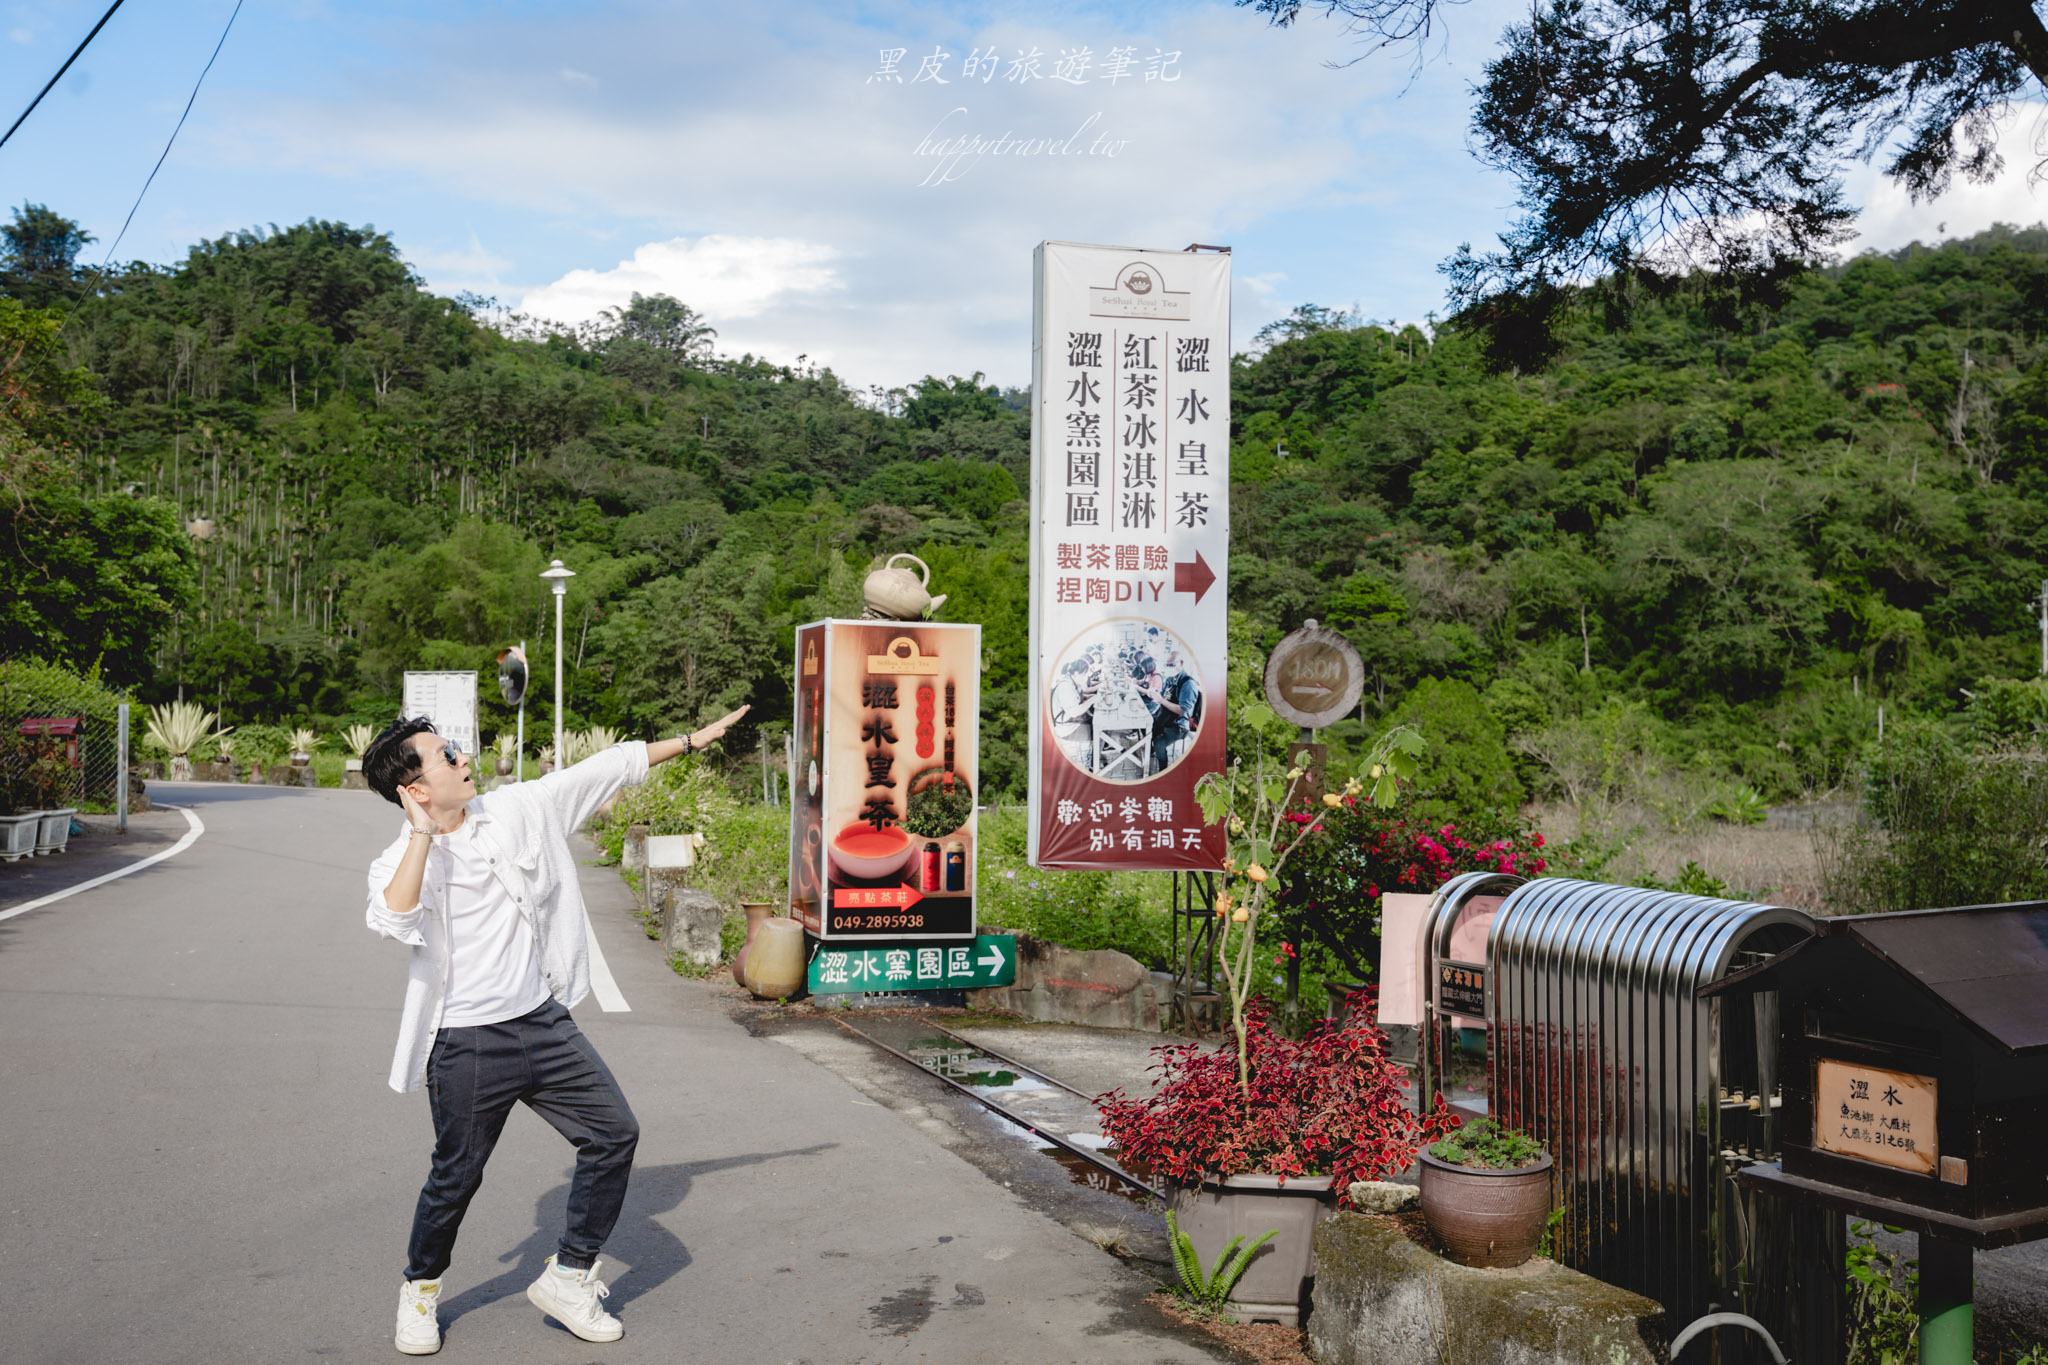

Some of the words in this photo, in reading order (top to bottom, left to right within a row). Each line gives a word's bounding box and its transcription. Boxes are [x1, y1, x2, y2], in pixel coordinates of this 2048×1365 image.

[1161, 299, 1178, 307] Tea
[1122, 333, 1158, 529] 紅茶冰淇淋
[1175, 337, 1210, 528] 澀水皇茶
[1057, 543, 1169, 571] 製茶體驗
[1057, 577, 1165, 604] 捏陶DIY
[859, 684, 899, 831] 澀水皇茶
[1057, 796, 1173, 825] 歡迎參觀
[1089, 827, 1202, 851] 別有洞天
[834, 915, 924, 929] 049-2895938
[1840, 1103, 1874, 1127] 魚池鄉
[1880, 1114, 1911, 1133] 大雁村
